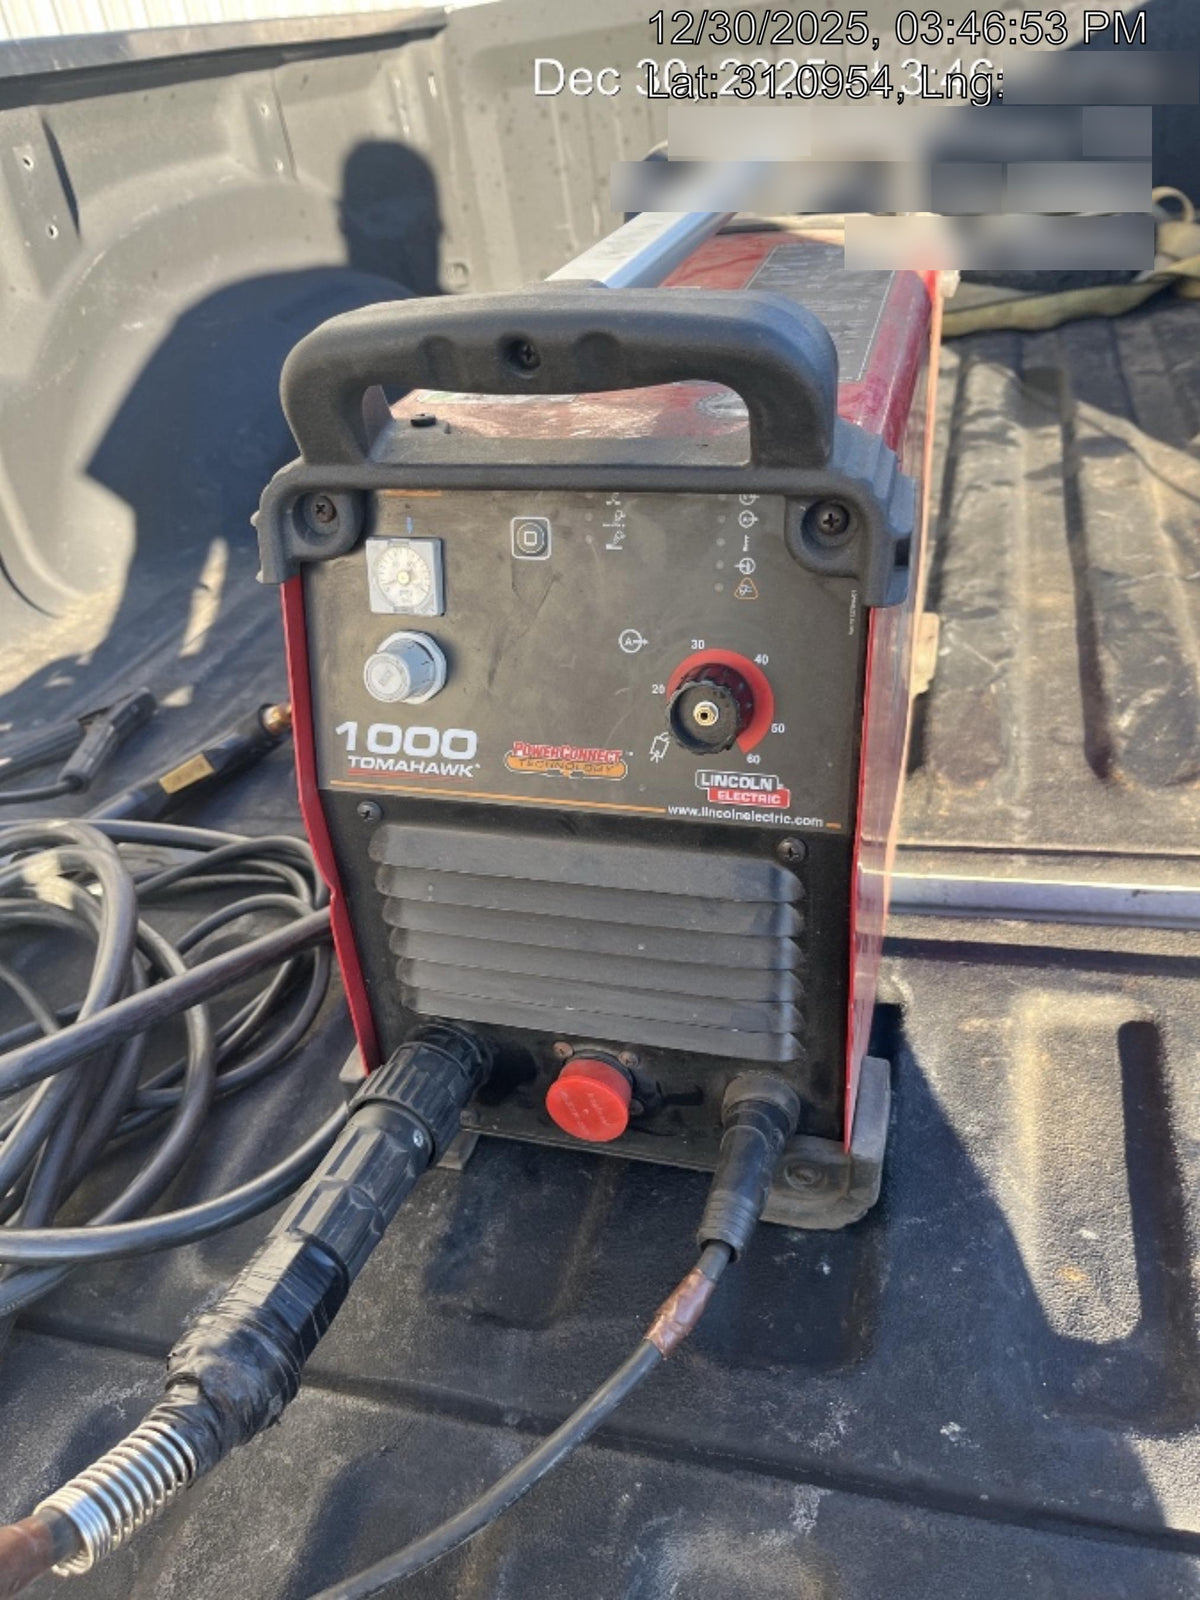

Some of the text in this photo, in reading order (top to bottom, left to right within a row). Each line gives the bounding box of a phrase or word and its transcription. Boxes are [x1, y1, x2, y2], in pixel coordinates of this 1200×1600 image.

[691, 639, 705, 649] 30
[754, 654, 769, 665] 40
[651, 684, 666, 694] 20
[335, 721, 478, 760] 1000
[746, 754, 761, 764] 60
[347, 755, 473, 778] TOMAHAWK
[701, 773, 772, 791] LINCOLN
[717, 791, 781, 804] ELECTRIC
[667, 805, 824, 828] www.lincolnelectric.com
